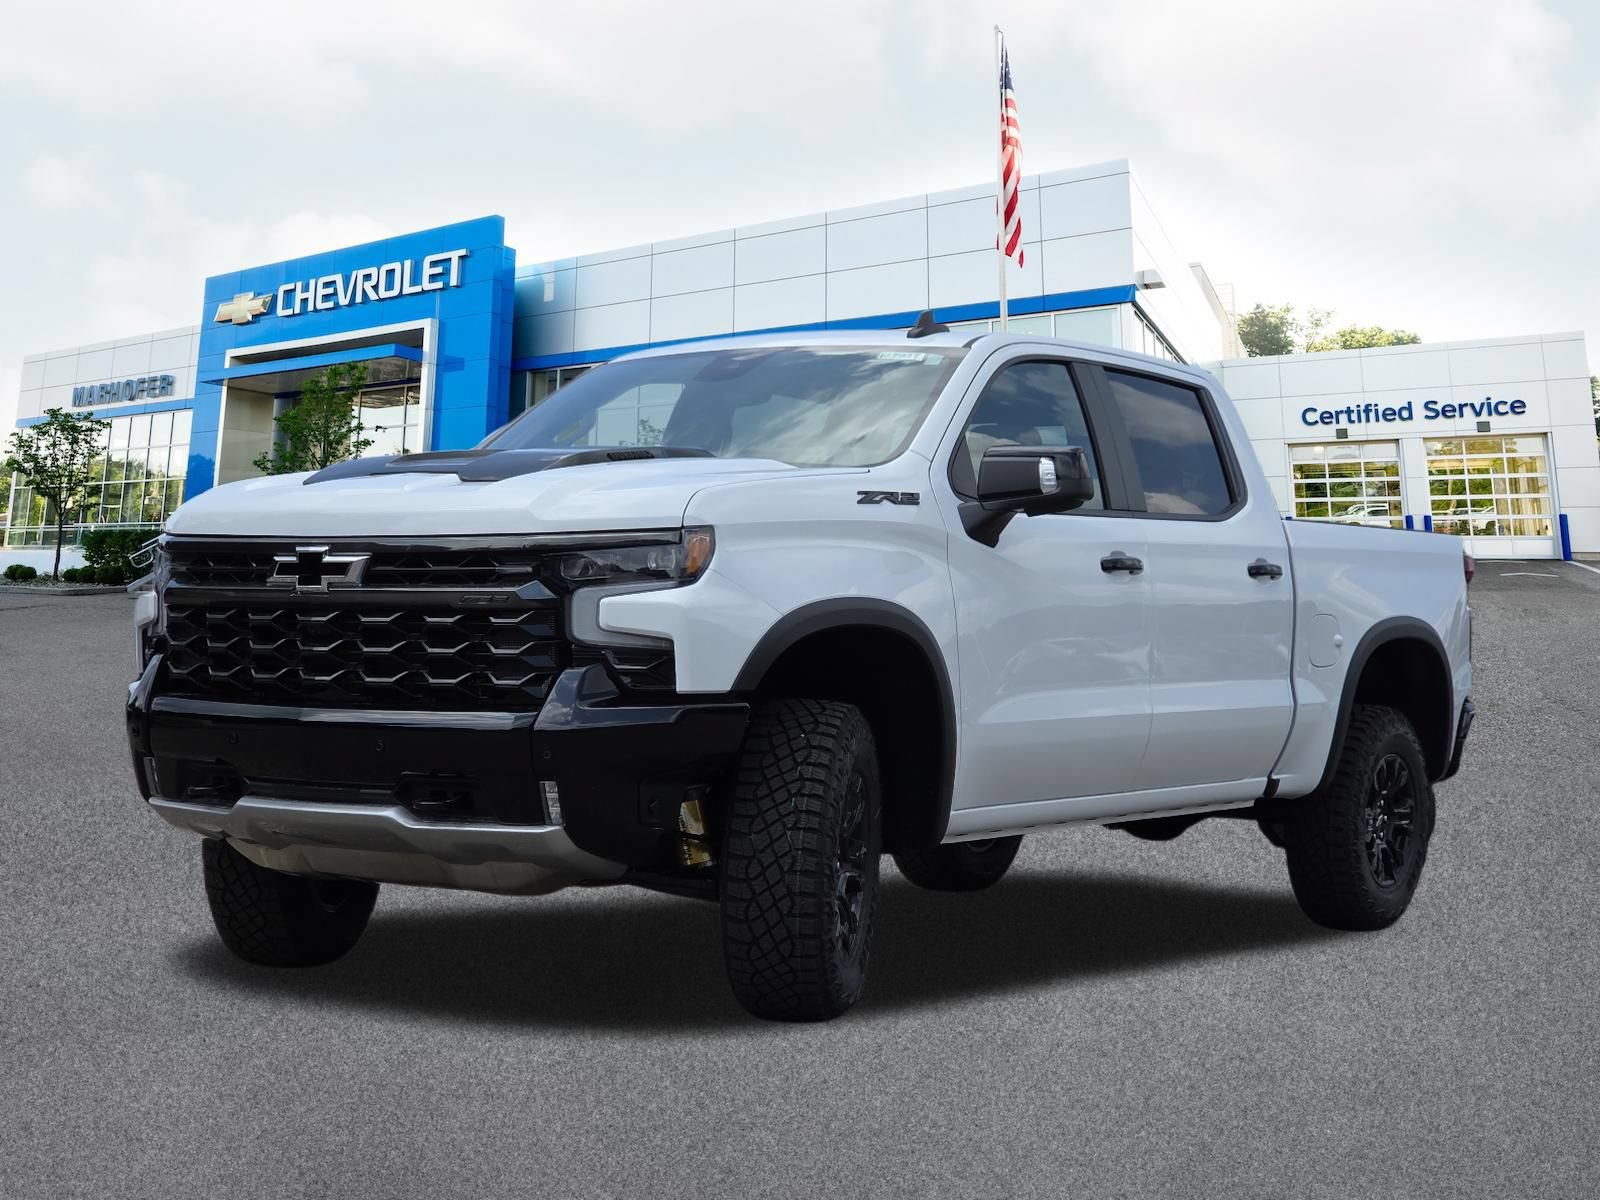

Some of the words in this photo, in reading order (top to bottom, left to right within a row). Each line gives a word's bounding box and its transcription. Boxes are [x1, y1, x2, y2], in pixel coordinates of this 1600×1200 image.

[276, 248, 469, 317] CHEVROLET
[72, 374, 176, 408] MARHOFER
[1301, 401, 1413, 426] Certified
[1423, 397, 1527, 420] Service
[856, 490, 921, 506] ZR2
